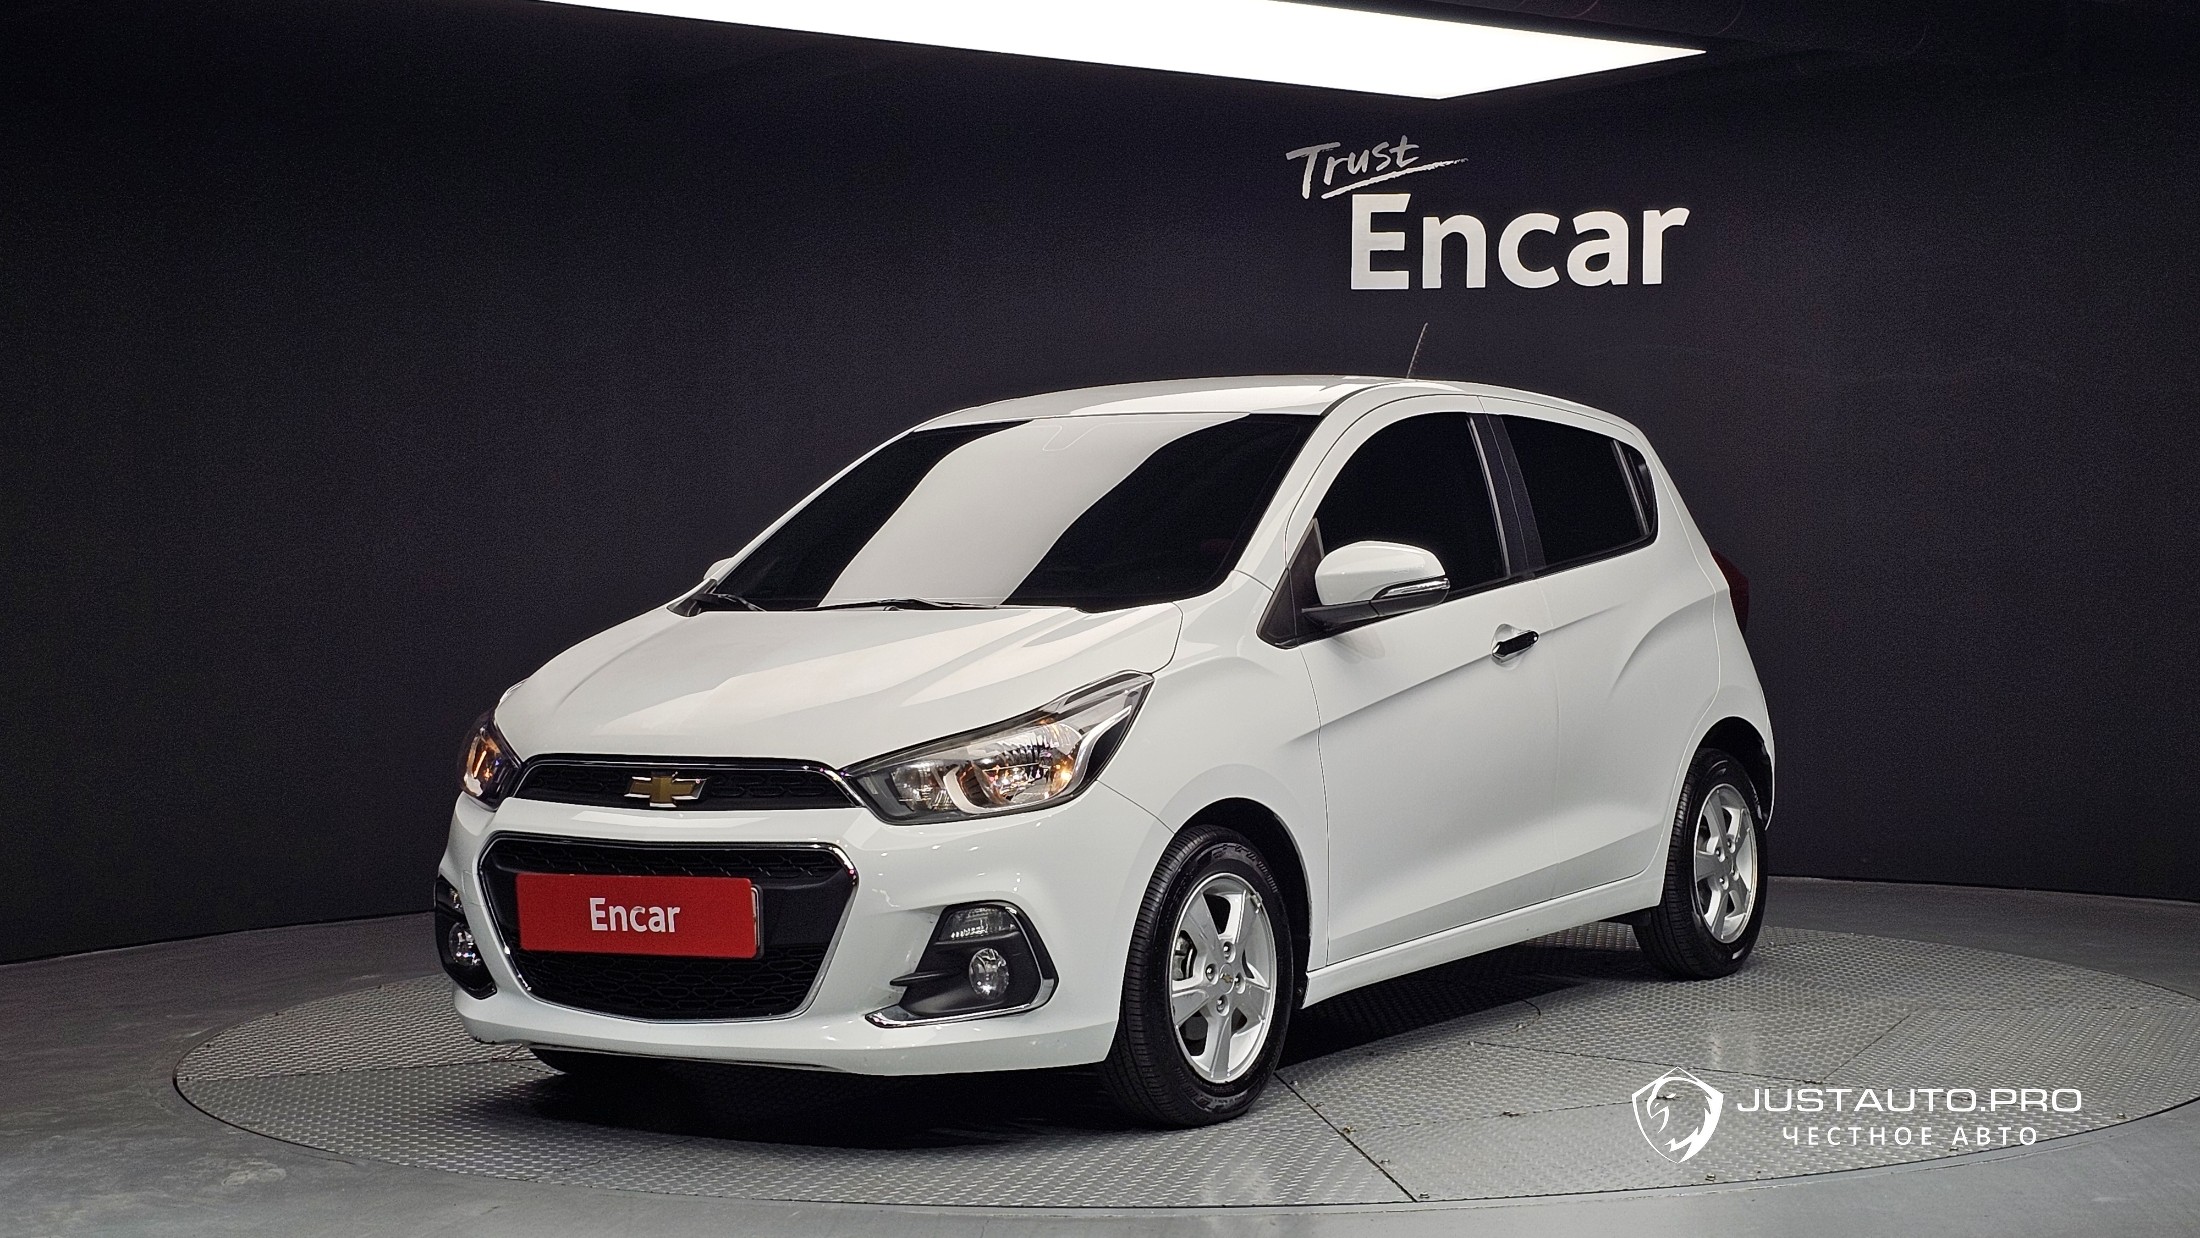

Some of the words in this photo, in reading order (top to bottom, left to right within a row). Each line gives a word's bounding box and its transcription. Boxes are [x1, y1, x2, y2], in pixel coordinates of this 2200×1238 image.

[1286, 135, 1420, 199] Trust
[1351, 193, 1690, 290] Encar
[589, 897, 681, 933] Encar
